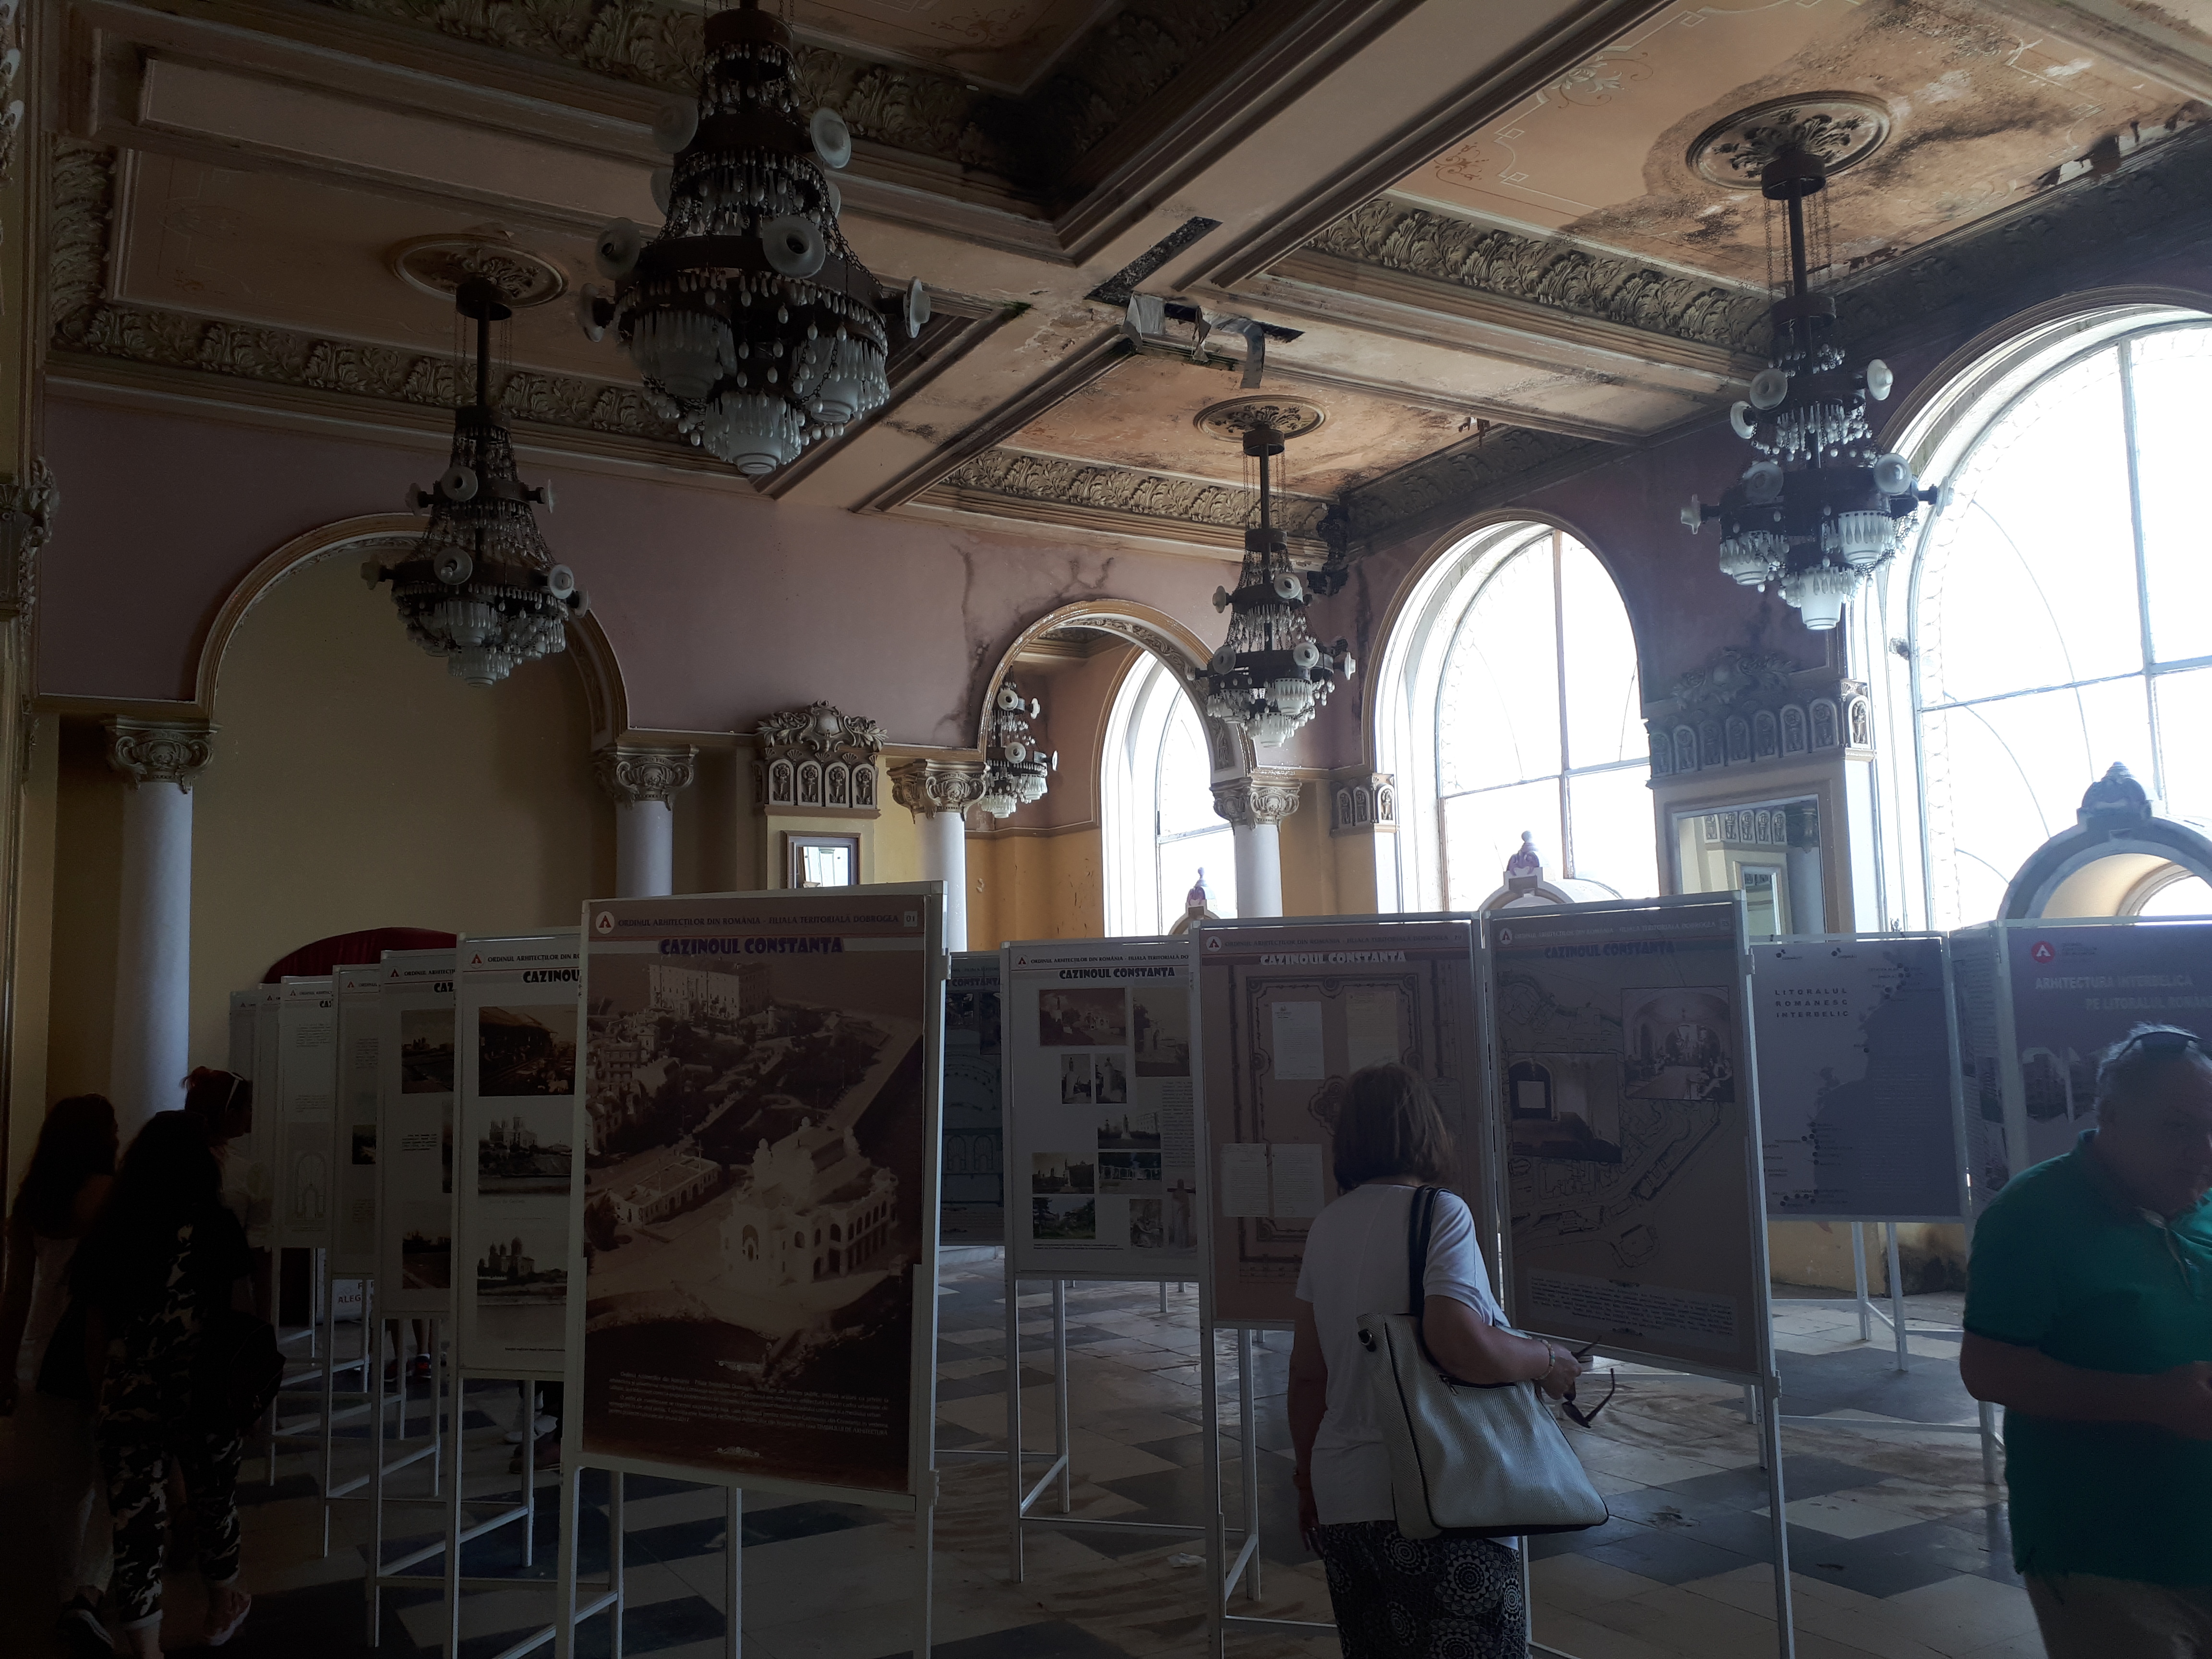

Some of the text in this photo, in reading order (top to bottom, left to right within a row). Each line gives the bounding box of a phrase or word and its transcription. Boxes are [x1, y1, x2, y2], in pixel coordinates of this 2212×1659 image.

[618, 918, 650, 926] ORDINUL
[707, 917, 720, 926] DIN
[769, 916, 798, 924] FILIALA
[853, 914, 900, 923] DOBROGEA
[660, 938, 741, 955] CAZINOUL
[1544, 944, 1601, 959] CAZINOUL
[1260, 952, 1326, 966] CAZINOUL
[1059, 969, 1111, 979] CAZINOUL
